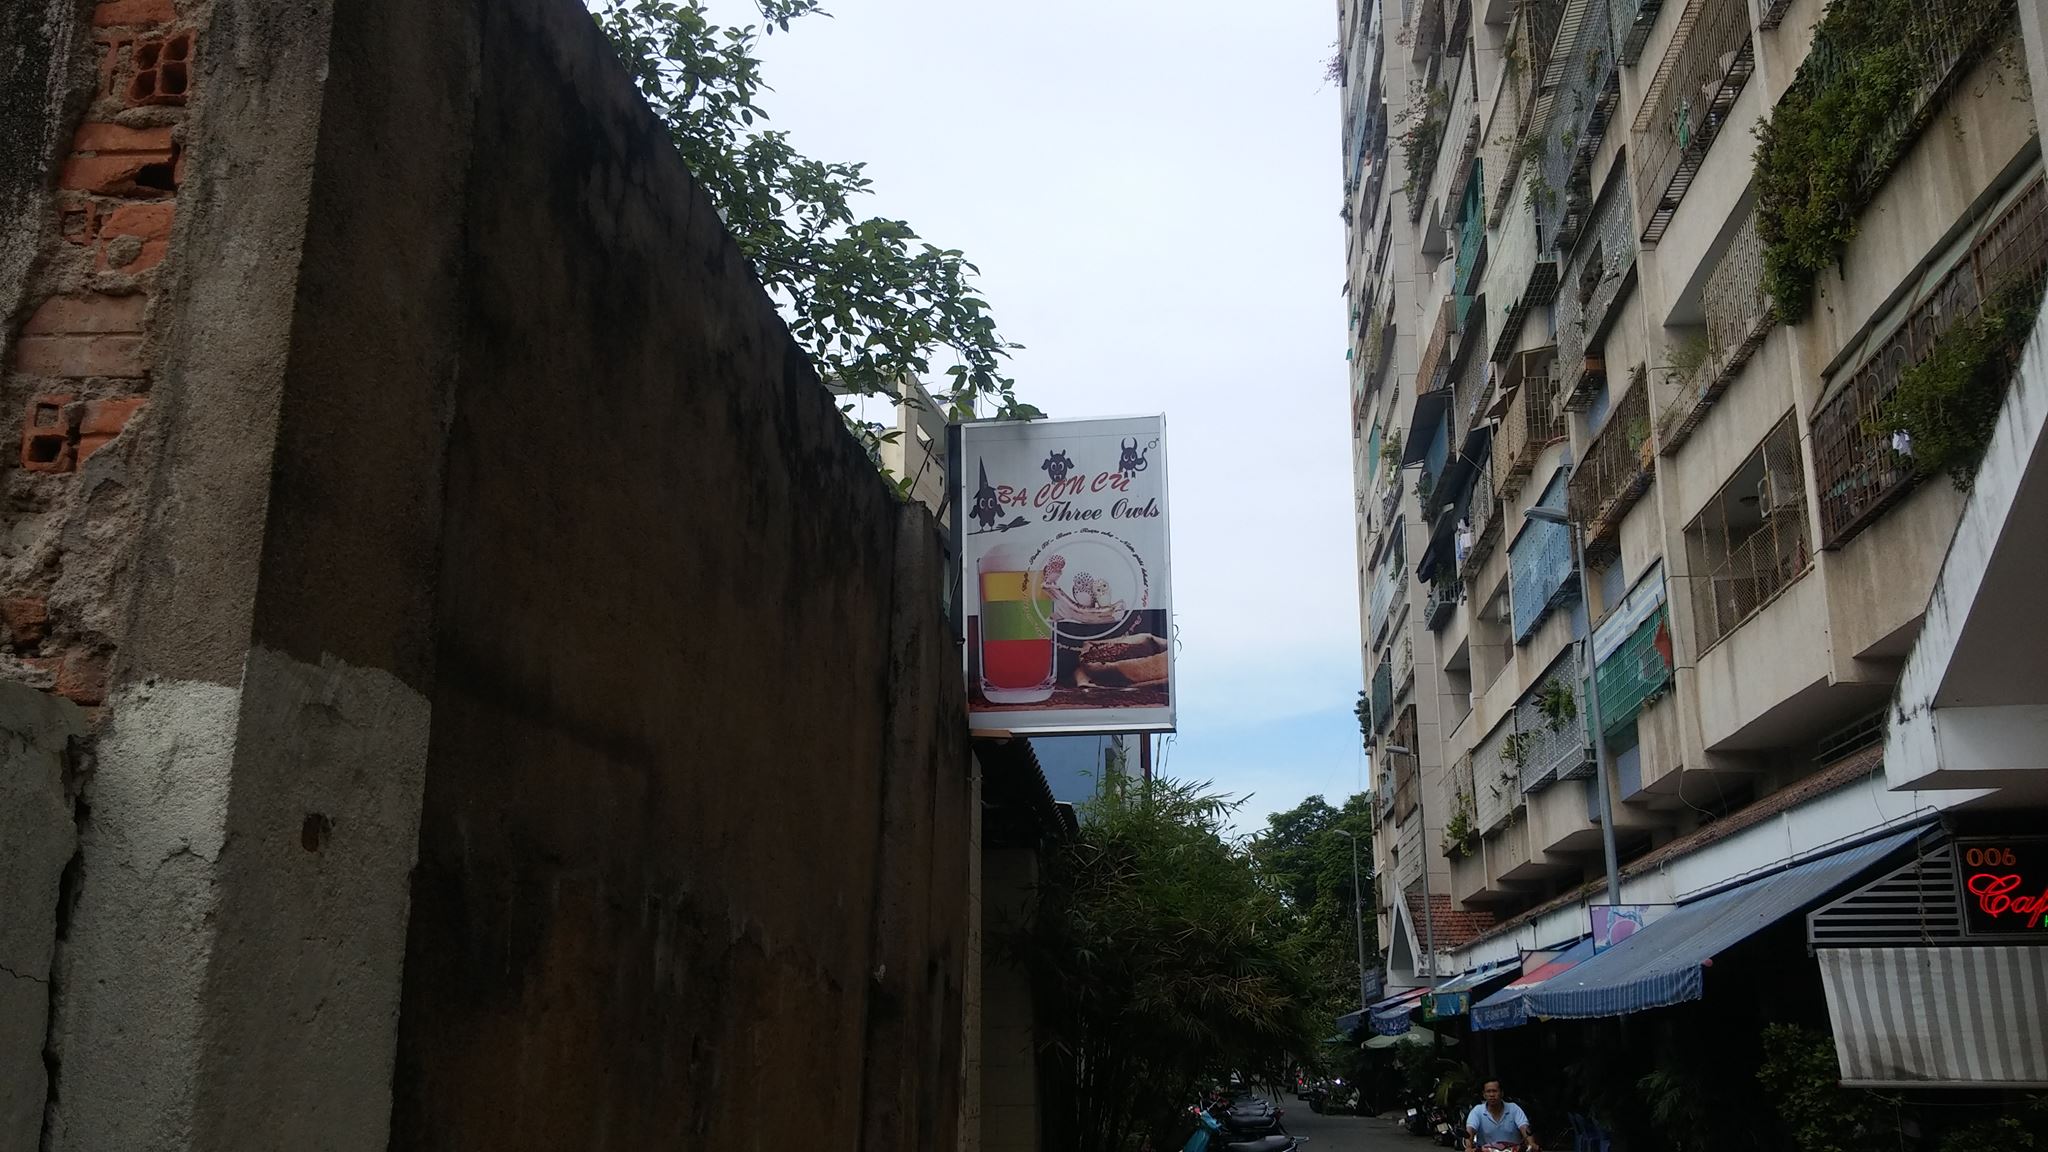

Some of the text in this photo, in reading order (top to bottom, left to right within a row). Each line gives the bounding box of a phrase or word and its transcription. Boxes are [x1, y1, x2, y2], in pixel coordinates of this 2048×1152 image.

[997, 485, 1027, 507] BA
[1033, 474, 1086, 508] CON
[1042, 497, 1161, 523] Three Owls
[1966, 847, 2017, 867] 006
